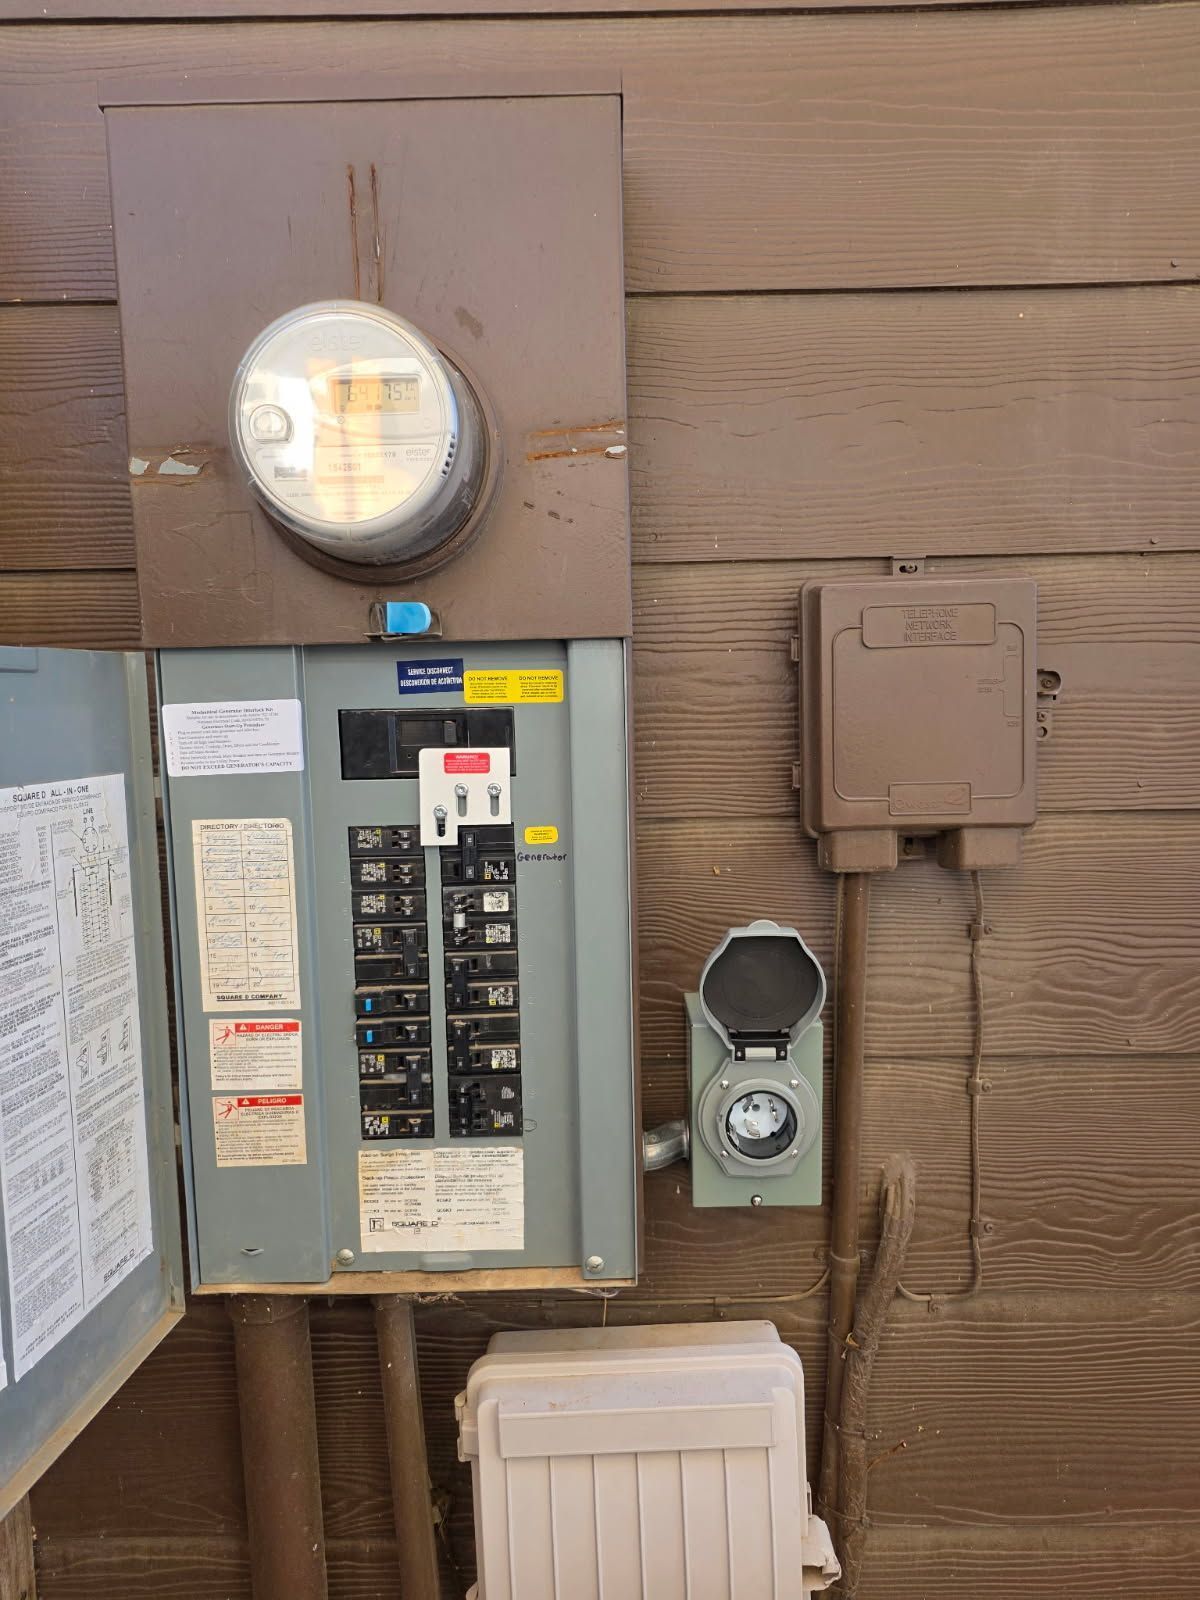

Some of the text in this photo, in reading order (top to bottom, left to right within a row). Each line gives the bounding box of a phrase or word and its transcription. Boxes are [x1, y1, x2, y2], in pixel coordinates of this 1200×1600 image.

[901, 608, 959, 619] TELEPHONE
[905, 620, 952, 631] NETWORK
[904, 632, 957, 642] INTERFACE
[427, 666, 453, 674] DISCONNECT
[13, 792, 39, 802] SQUARE
[517, 852, 567, 862] Generator
